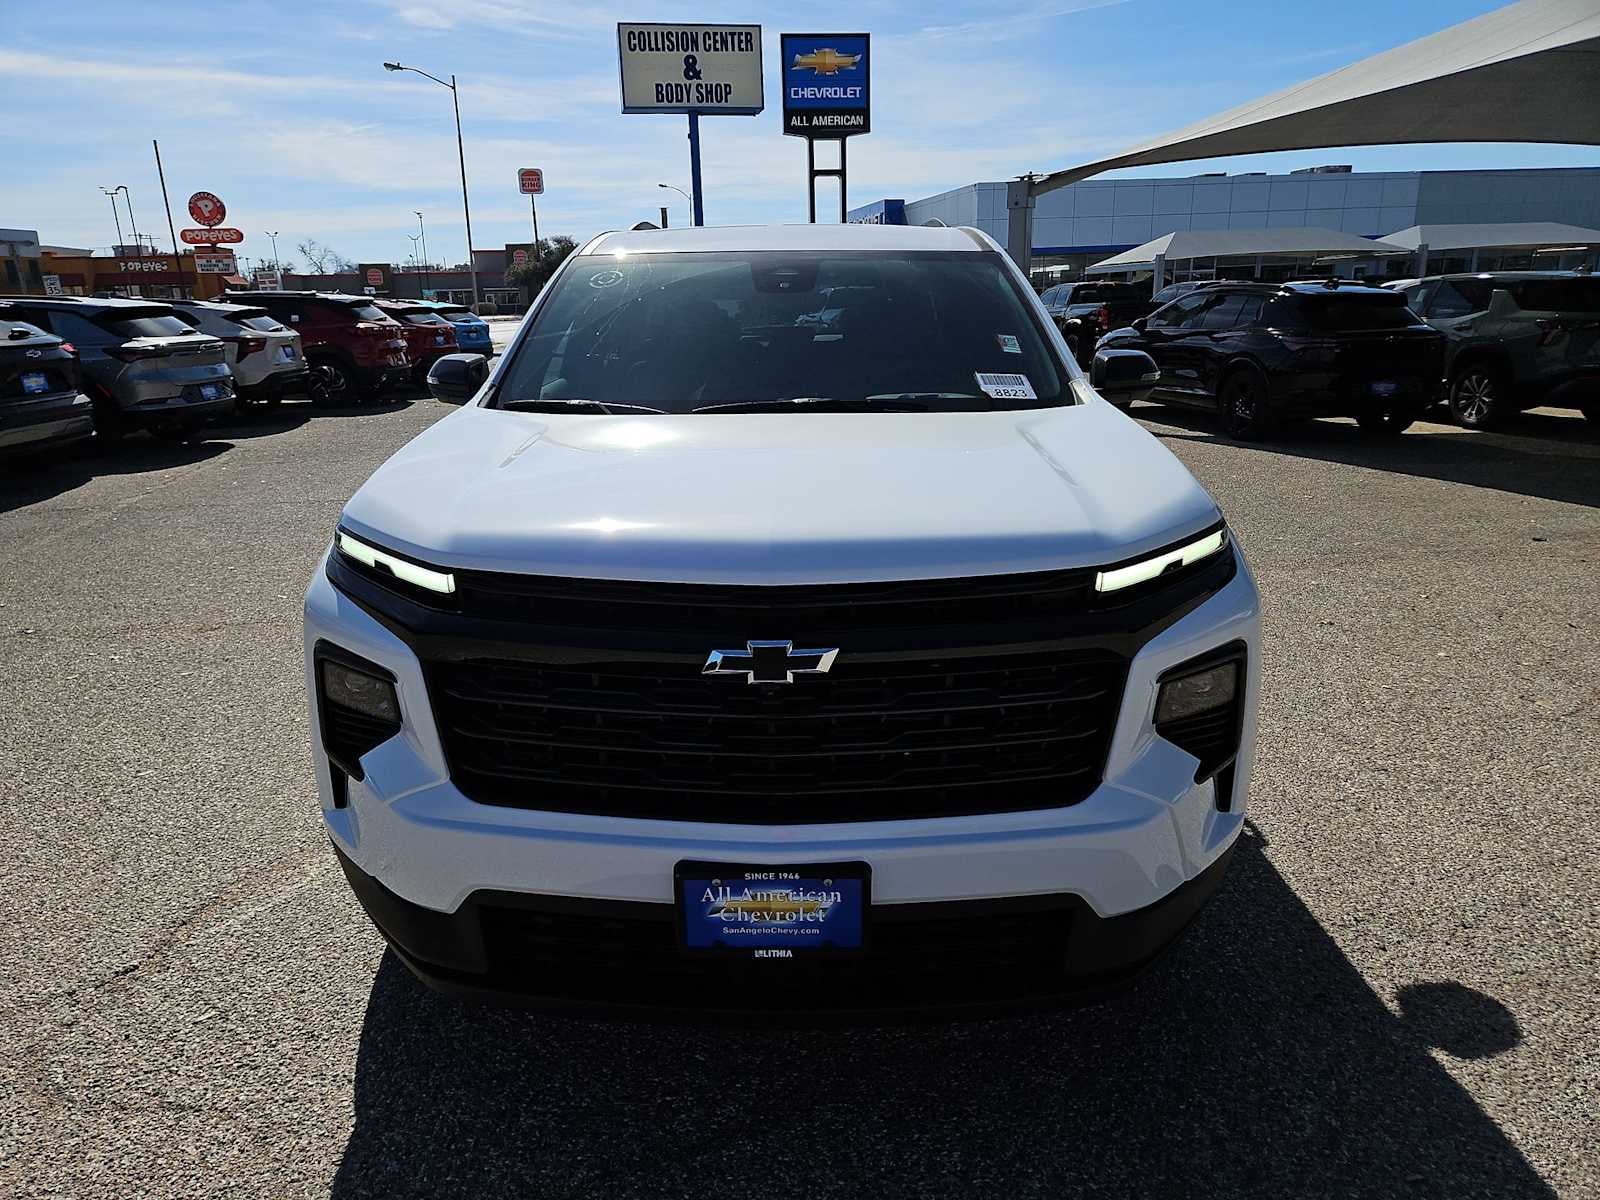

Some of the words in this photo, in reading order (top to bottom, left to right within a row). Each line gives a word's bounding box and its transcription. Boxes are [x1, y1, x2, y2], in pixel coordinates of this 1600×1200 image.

[627, 31, 699, 52] COLLISION
[703, 32, 753, 52] CENTER
[683, 55, 702, 80] &
[655, 83, 692, 103] BODY
[696, 83, 732, 103] SHOP
[791, 87, 862, 99] CHEVROLET
[790, 115, 810, 126] ALL
[812, 115, 864, 126] AMERICAN
[47, 286, 61, 295] 35
[994, 388, 1027, 398] 8823
[744, 872, 776, 881] SINCE
[779, 872, 800, 880] 1946
[701, 886, 731, 903] All
[741, 887, 842, 903] American
[719, 907, 825, 923] Chevrolet
[722, 926, 820, 936] SanAngeloChevy.com
